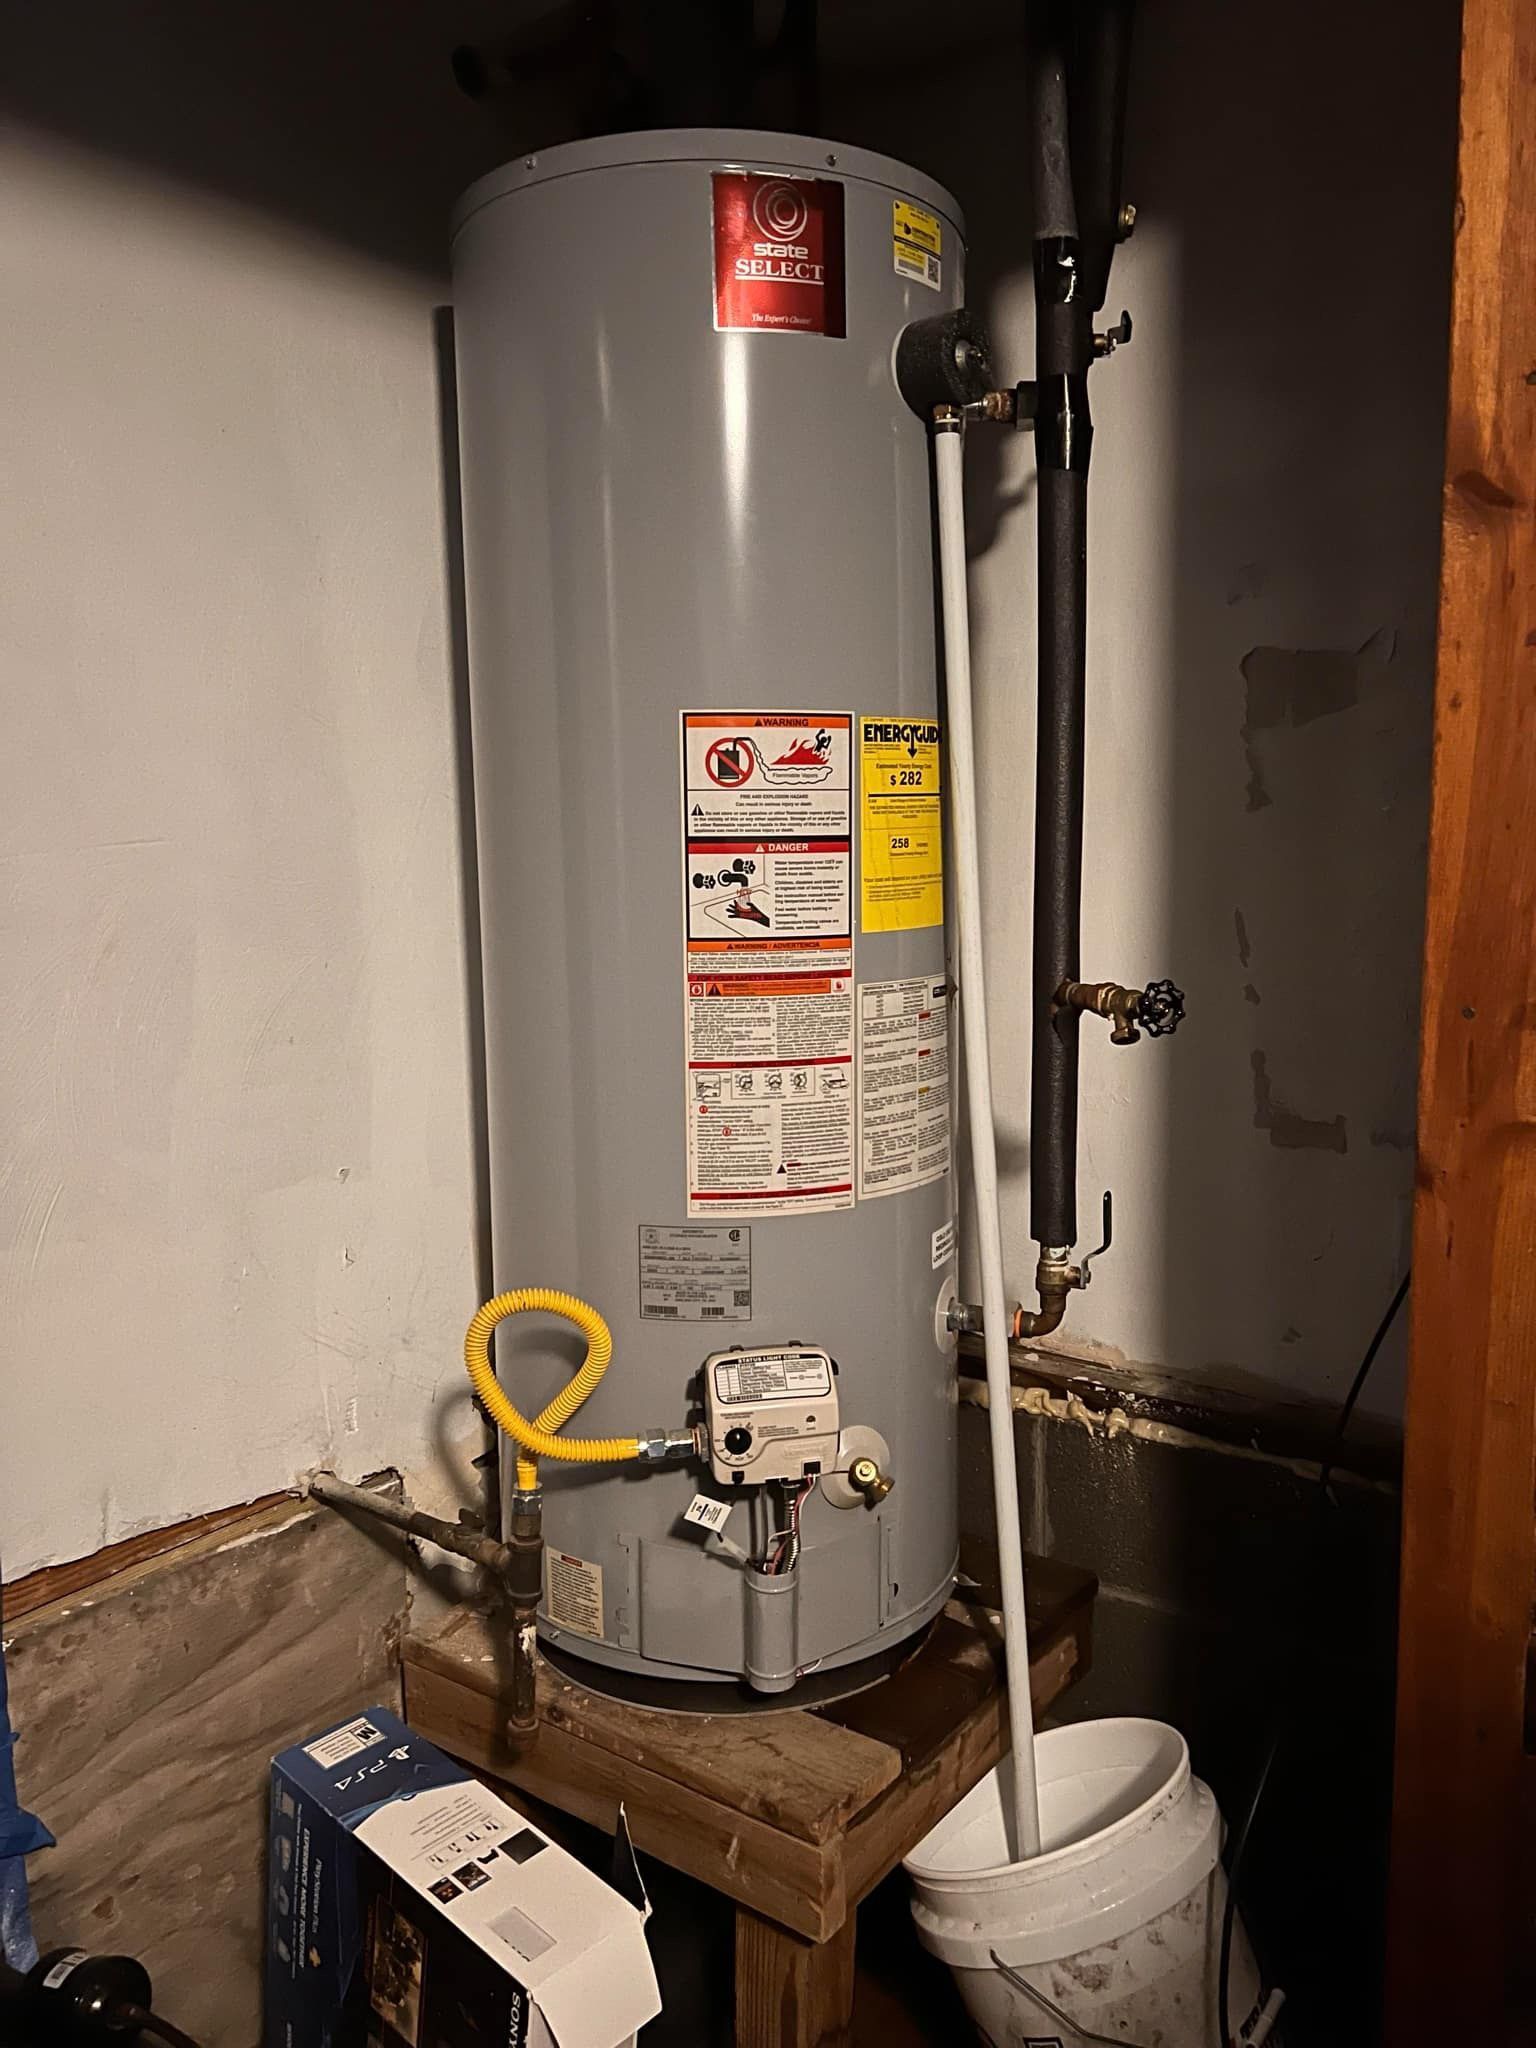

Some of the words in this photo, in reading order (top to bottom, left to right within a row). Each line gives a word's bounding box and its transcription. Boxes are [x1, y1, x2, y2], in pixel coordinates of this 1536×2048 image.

[753, 242, 808, 259] state
[735, 259, 824, 280] SELECT
[763, 718, 809, 727] WARNING
[900, 771, 922, 786] 282
[768, 843, 808, 851] DANGER
[891, 838, 909, 849] 258
[356, 1727, 377, 1740] M
[334, 1760, 388, 1790] PS4
[508, 1992, 520, 2048] SONY
